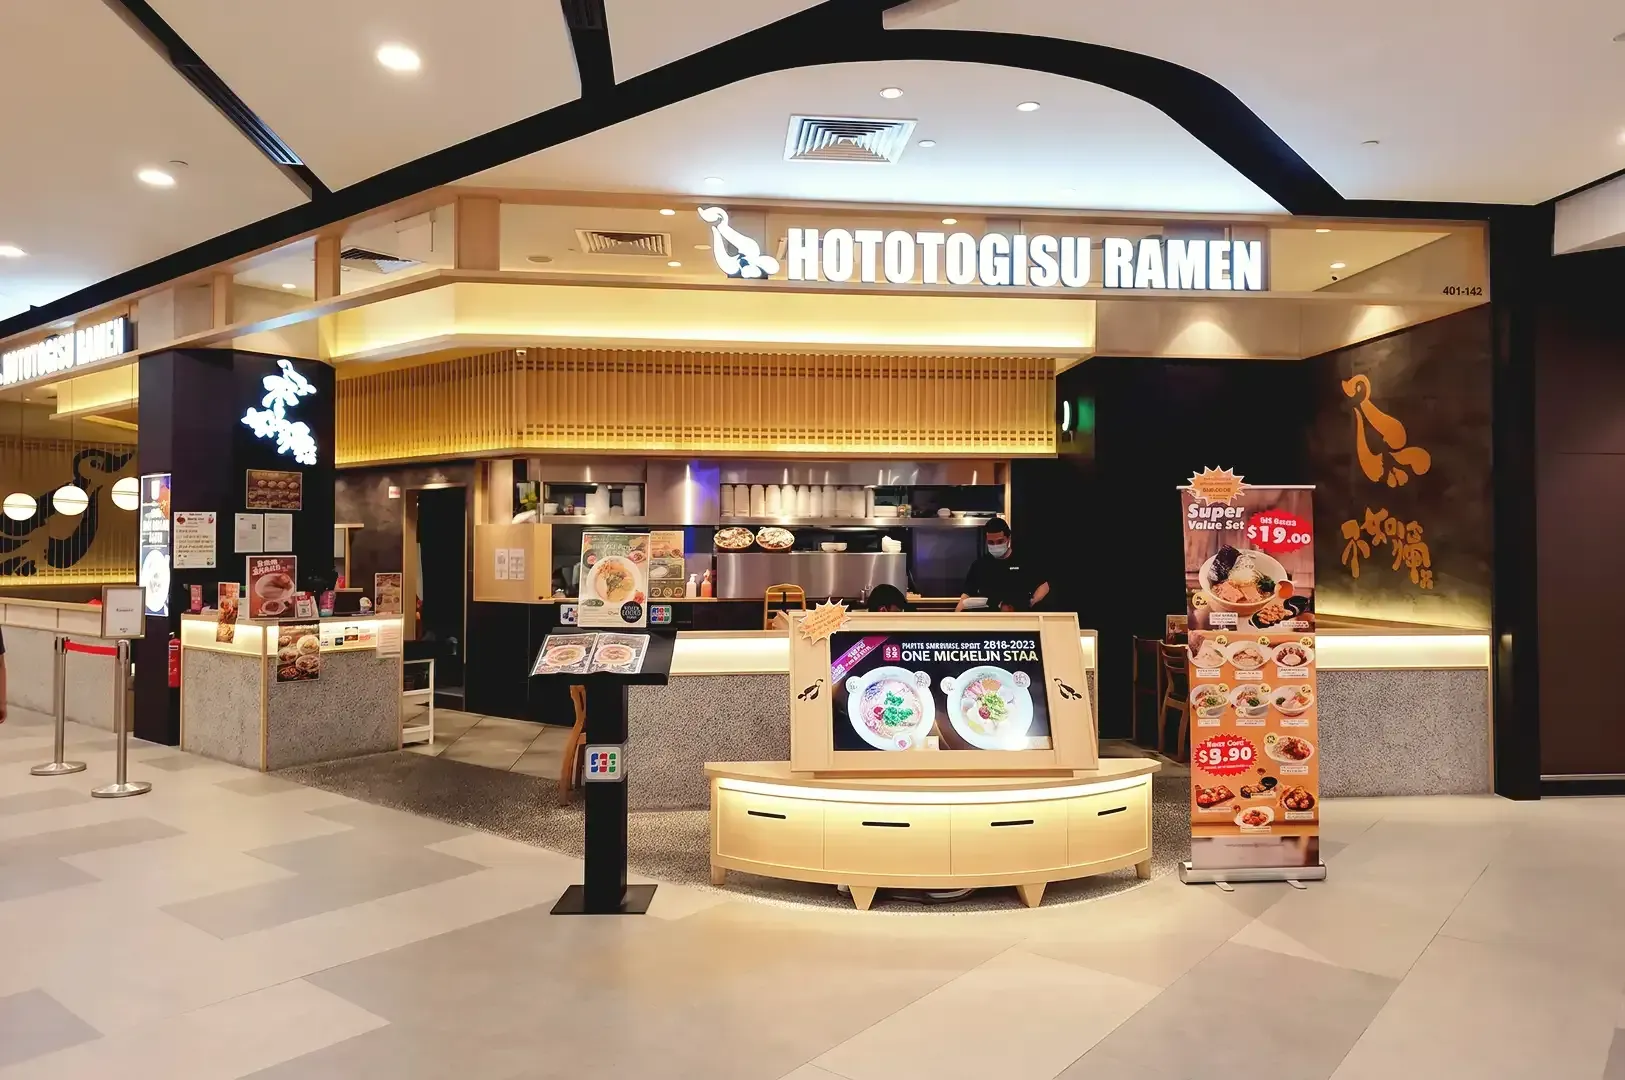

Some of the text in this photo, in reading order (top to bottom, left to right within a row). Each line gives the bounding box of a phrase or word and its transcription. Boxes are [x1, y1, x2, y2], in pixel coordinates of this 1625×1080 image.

[788, 228, 1261, 291] HOTOTOGISU RAMEN
[1442, 285, 1483, 296] 401-142
[1187, 502, 1245, 522] Super
[1188, 519, 1223, 531] Value
[1225, 519, 1245, 531] Set
[1246, 524, 1312, 545] $19.00
[901, 650, 932, 663] ONE
